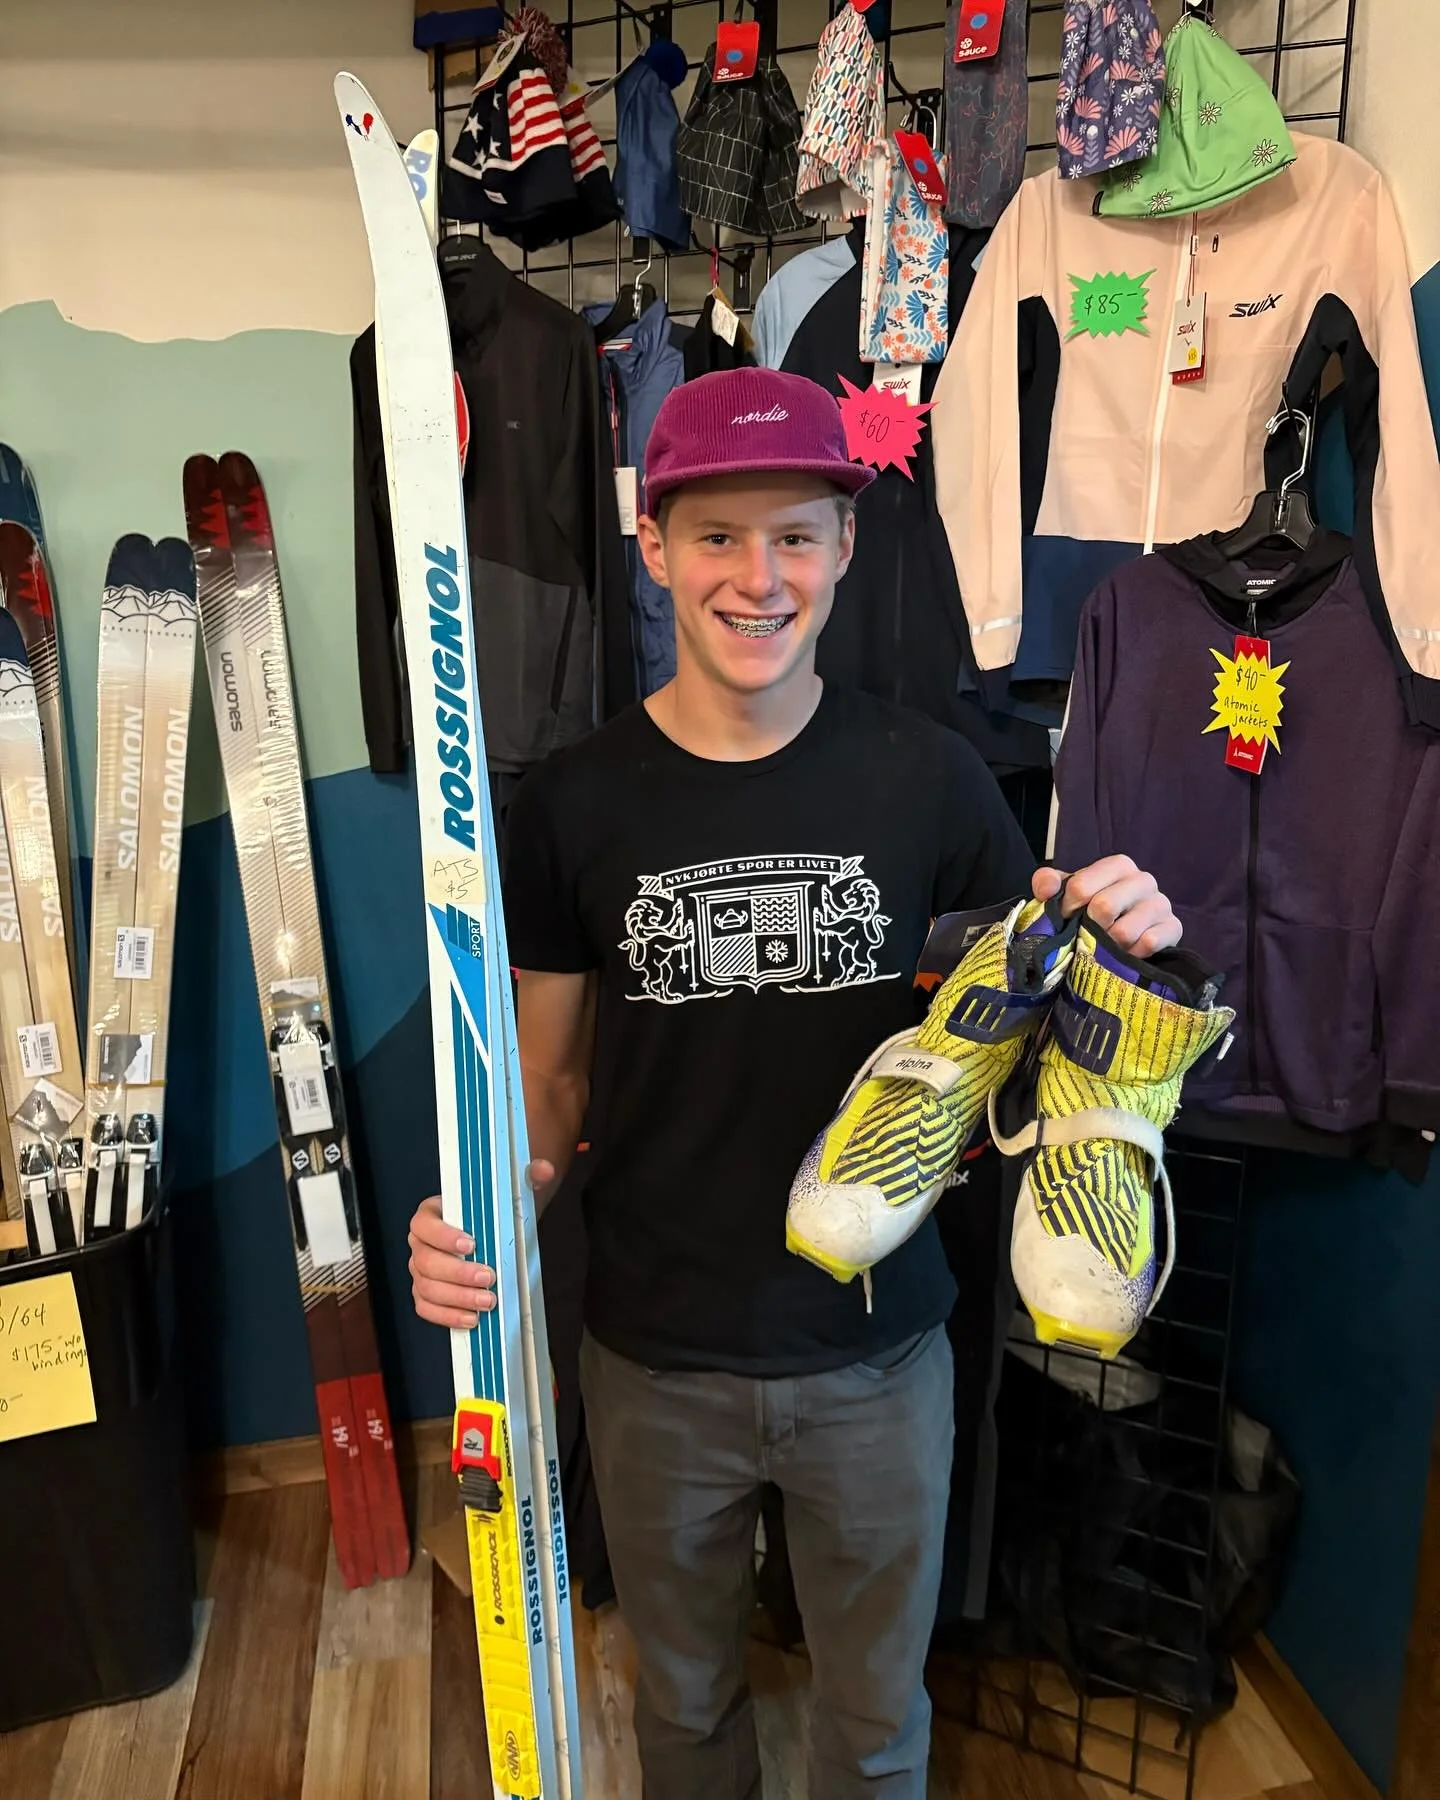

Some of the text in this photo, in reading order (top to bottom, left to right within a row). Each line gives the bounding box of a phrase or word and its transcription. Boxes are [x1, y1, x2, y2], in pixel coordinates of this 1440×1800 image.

[959, 45, 987, 57] sauce
[921, 191, 943, 201] sauce
[731, 403, 789, 425] nordie
[424, 541, 475, 852] ROSSIGNOL
[118, 705, 144, 872] SALOMON
[158, 708, 189, 873] SALOMON
[665, 860, 836, 886] NYKJØRTE SPOR ER LIVET
[471, 920, 481, 957] SPORT
[895, 1057, 934, 1071] alpina
[548, 1459, 568, 1604] ROSSIGNOL
[521, 1495, 543, 1645] ROSSIGNOL
